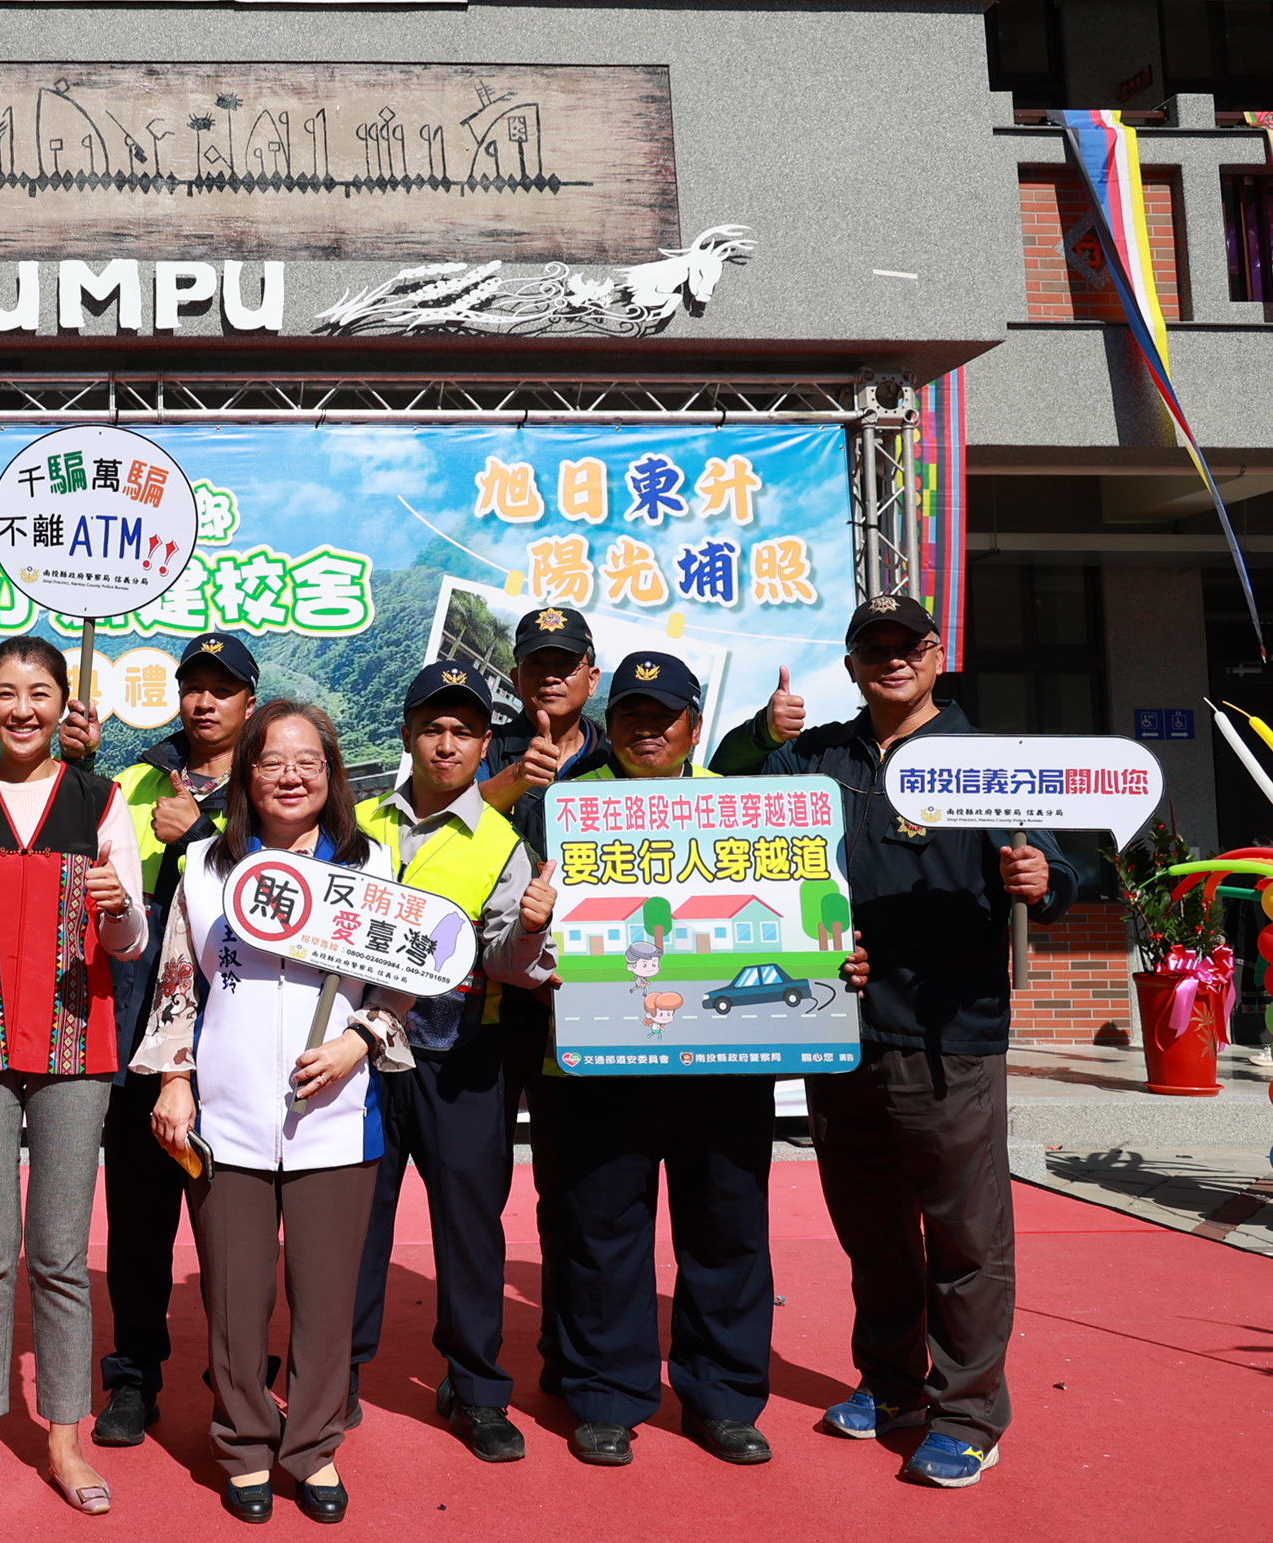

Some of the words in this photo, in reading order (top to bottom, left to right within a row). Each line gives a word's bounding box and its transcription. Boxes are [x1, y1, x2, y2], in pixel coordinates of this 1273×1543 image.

[18, 450, 169, 508] 千騙萬騙
[477, 456, 759, 522] 旭日東升
[530, 537, 815, 603] 陽光埔照
[899, 768, 1149, 795] 南投信義分局關心您
[556, 791, 832, 833] 不要在路段中任意穿越道路
[561, 834, 831, 885] 要走行人穿越道
[249, 874, 299, 924] 賄
[323, 873, 427, 927] 反賄選
[331, 910, 438, 967] 愛臺灣
[584, 1053, 670, 1065] 交通部道安委員會
[695, 1052, 782, 1063] 南投縣政府警察局
